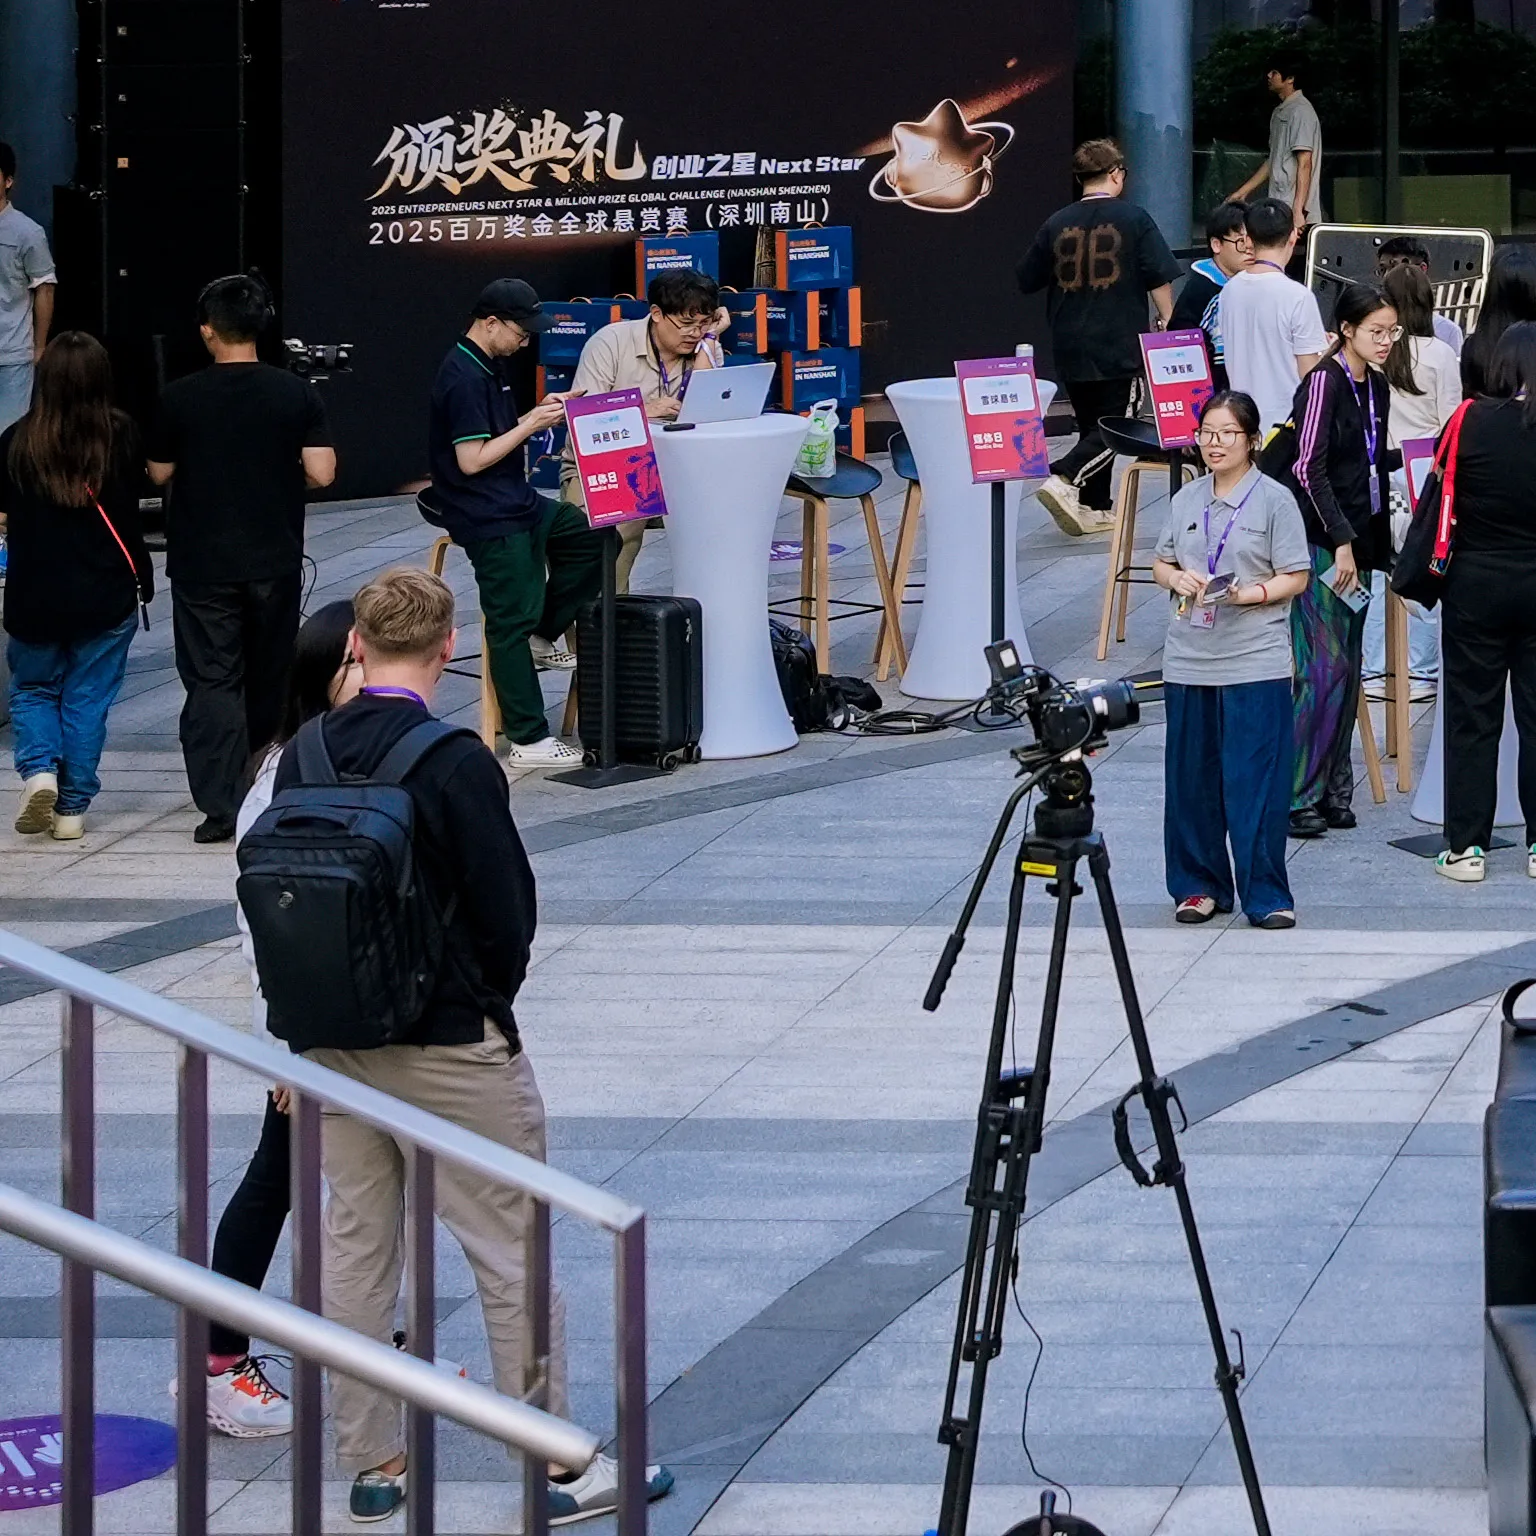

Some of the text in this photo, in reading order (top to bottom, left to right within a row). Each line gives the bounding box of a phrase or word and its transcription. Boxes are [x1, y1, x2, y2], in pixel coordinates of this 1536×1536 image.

[364, 108, 648, 202] 颁奖典礼
[650, 151, 867, 180] 创业之星 Next Star
[371, 183, 832, 215] 2025 ENTREPRENEURS NEXT STAR & MILLION PRIZE GLOBAL CHALLENGE (NANSHAN SHENZHEN)
[789, 251, 830, 260] IN NANSHAN
[794, 370, 836, 380] IN NANSHAN
